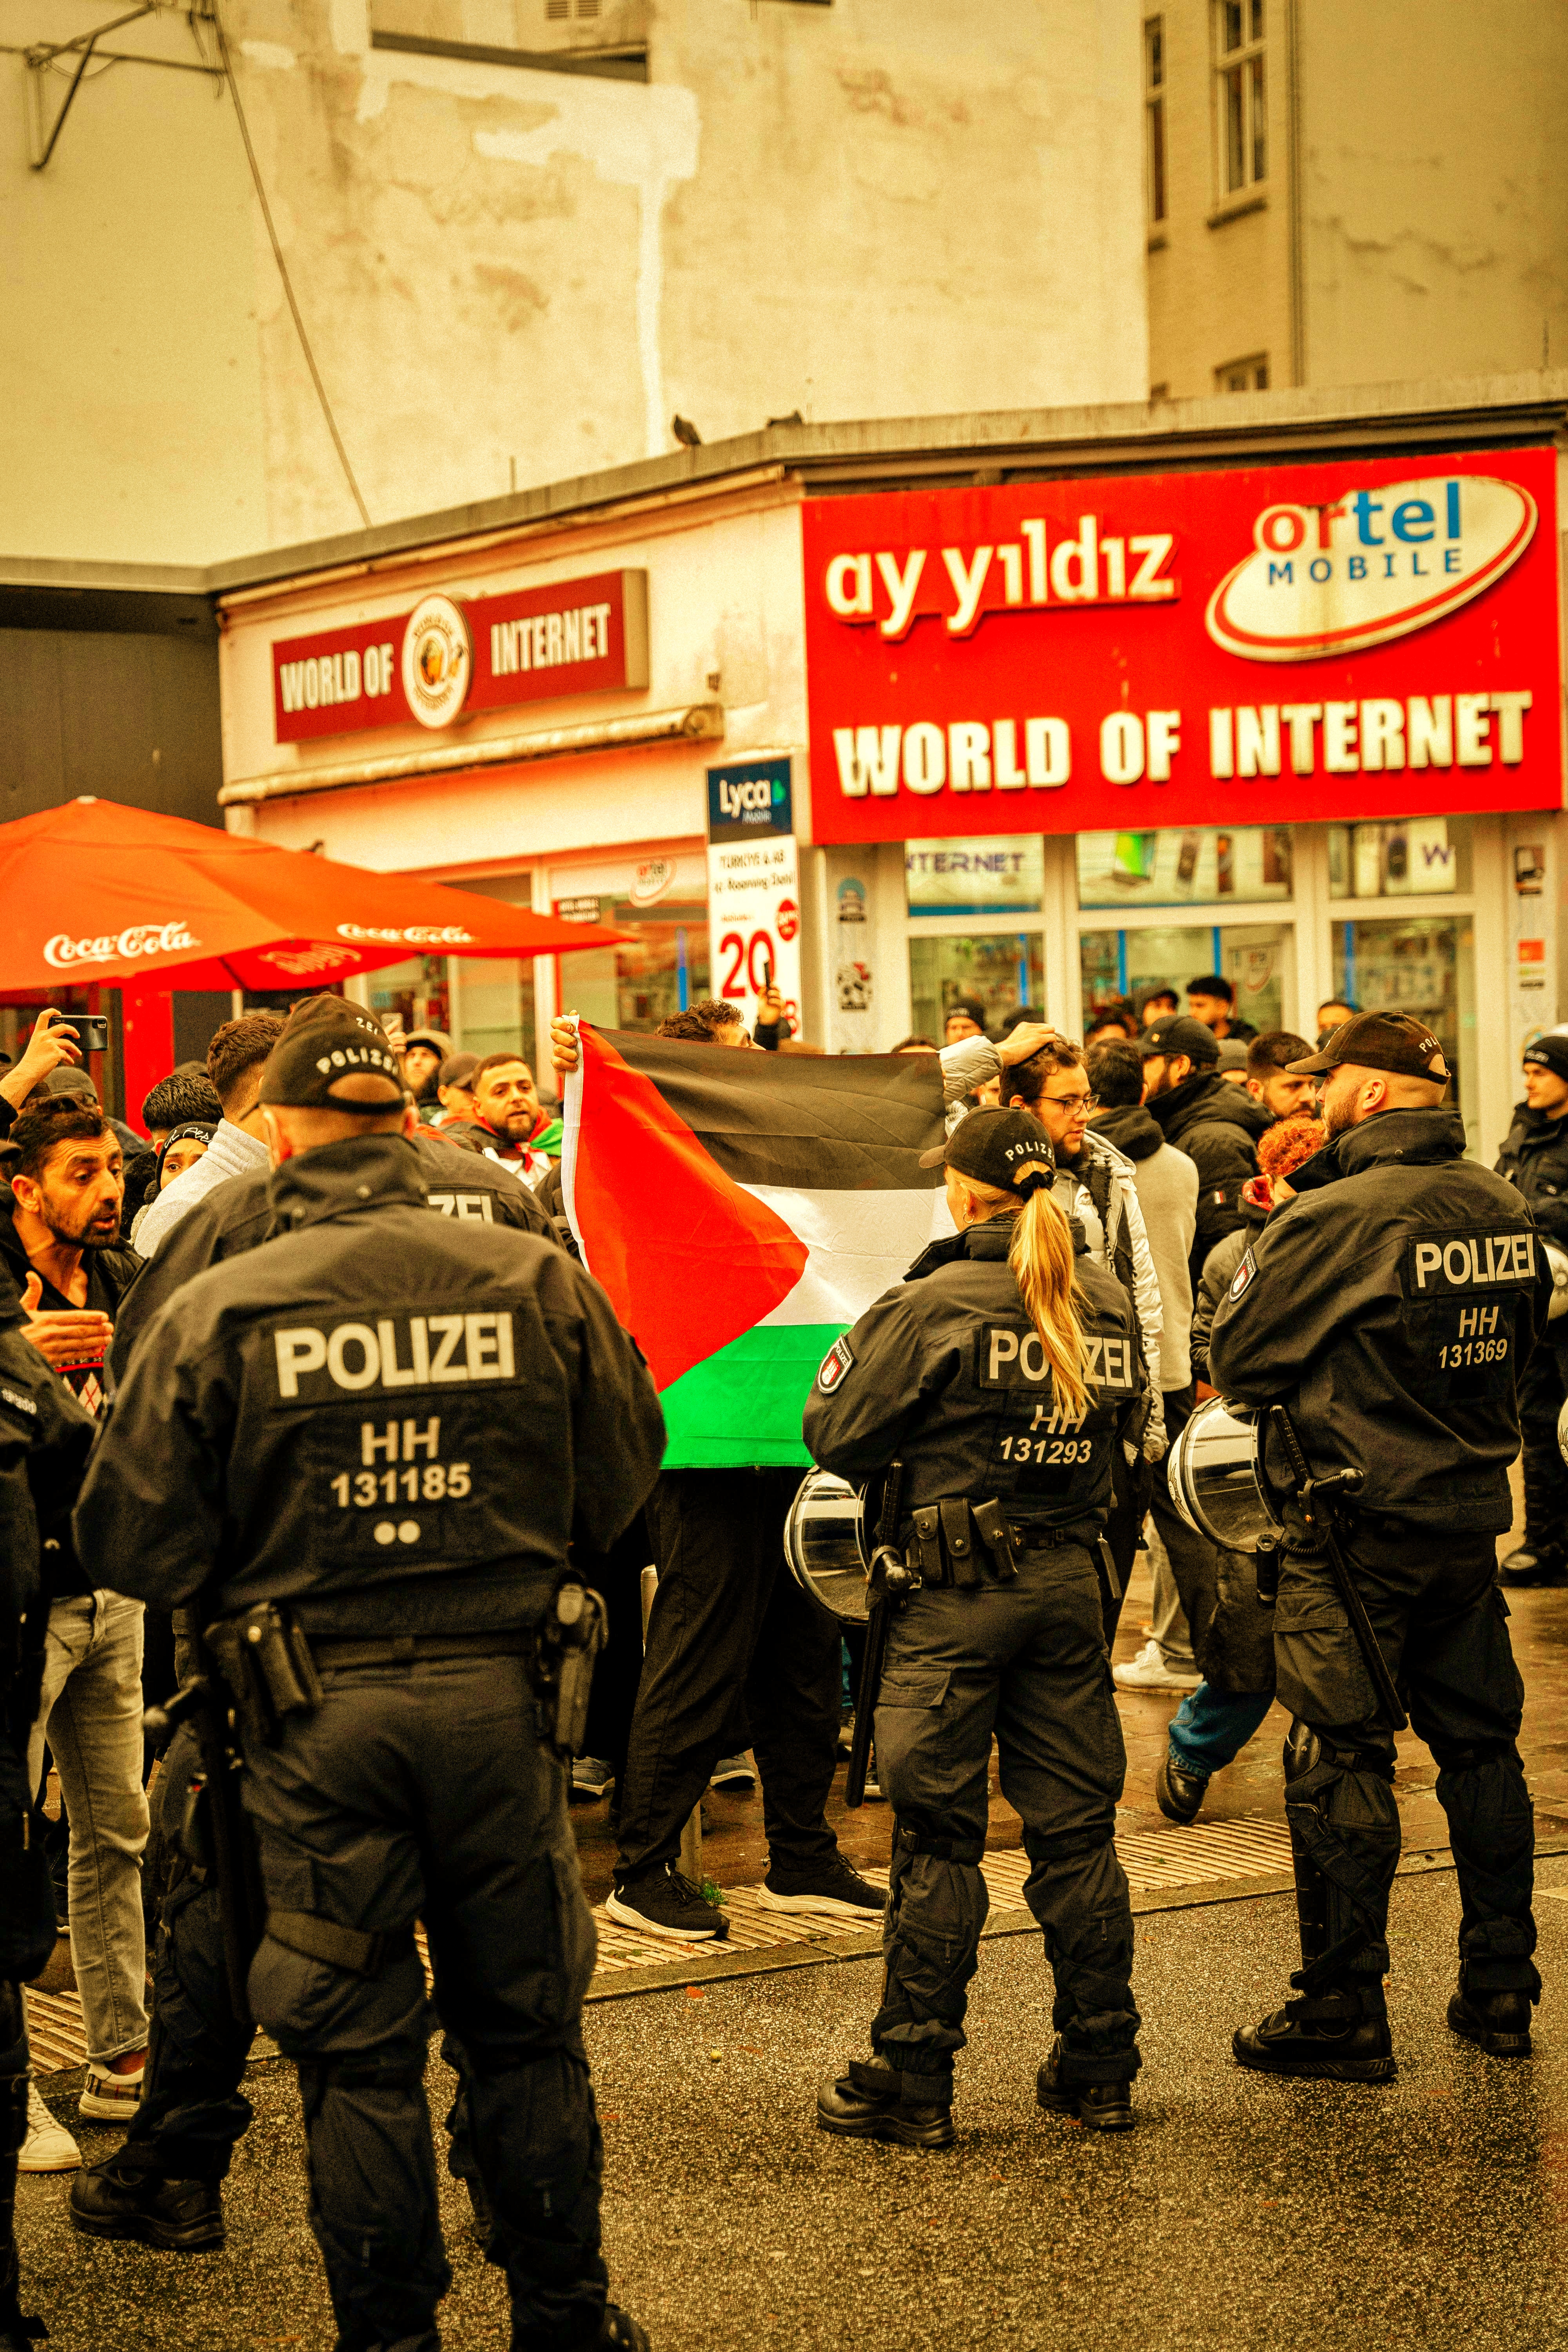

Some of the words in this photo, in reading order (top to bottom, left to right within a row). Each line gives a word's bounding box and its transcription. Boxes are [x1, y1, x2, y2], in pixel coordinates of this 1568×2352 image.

[1262, 482, 1461, 553] ortel
[1268, 549, 1463, 586] MOBILE
[826, 548, 926, 637] ay
[280, 651, 361, 713] WORLD
[364, 643, 394, 698] OF
[490, 603, 610, 677] INTERNET
[834, 717, 1070, 797] WORLD
[1100, 710, 1181, 785] OF
[1210, 691, 1532, 779] INTERNET
[720, 779, 771, 818] Lyca
[44, 921, 203, 968] Coca-Cola
[720, 931, 774, 998] 20
[1419, 1036, 1439, 1052] POLI
[1005, 1141, 1054, 1162] POLIZEI
[1416, 1234, 1536, 1288] POLIZEI
[1459, 1306, 1499, 1338] HH
[274, 1312, 515, 1398] POLIZEI
[835, 1342, 849, 1368] POLIZEI
[989, 1330, 1132, 1388] POZEI
[1439, 1338, 1508, 1369] 131369
[361, 1416, 441, 1466] HH
[1030, 1405, 1087, 1434] HH
[1000, 1436, 1092, 1464] 131293
[330, 1463, 471, 1508] 131185
